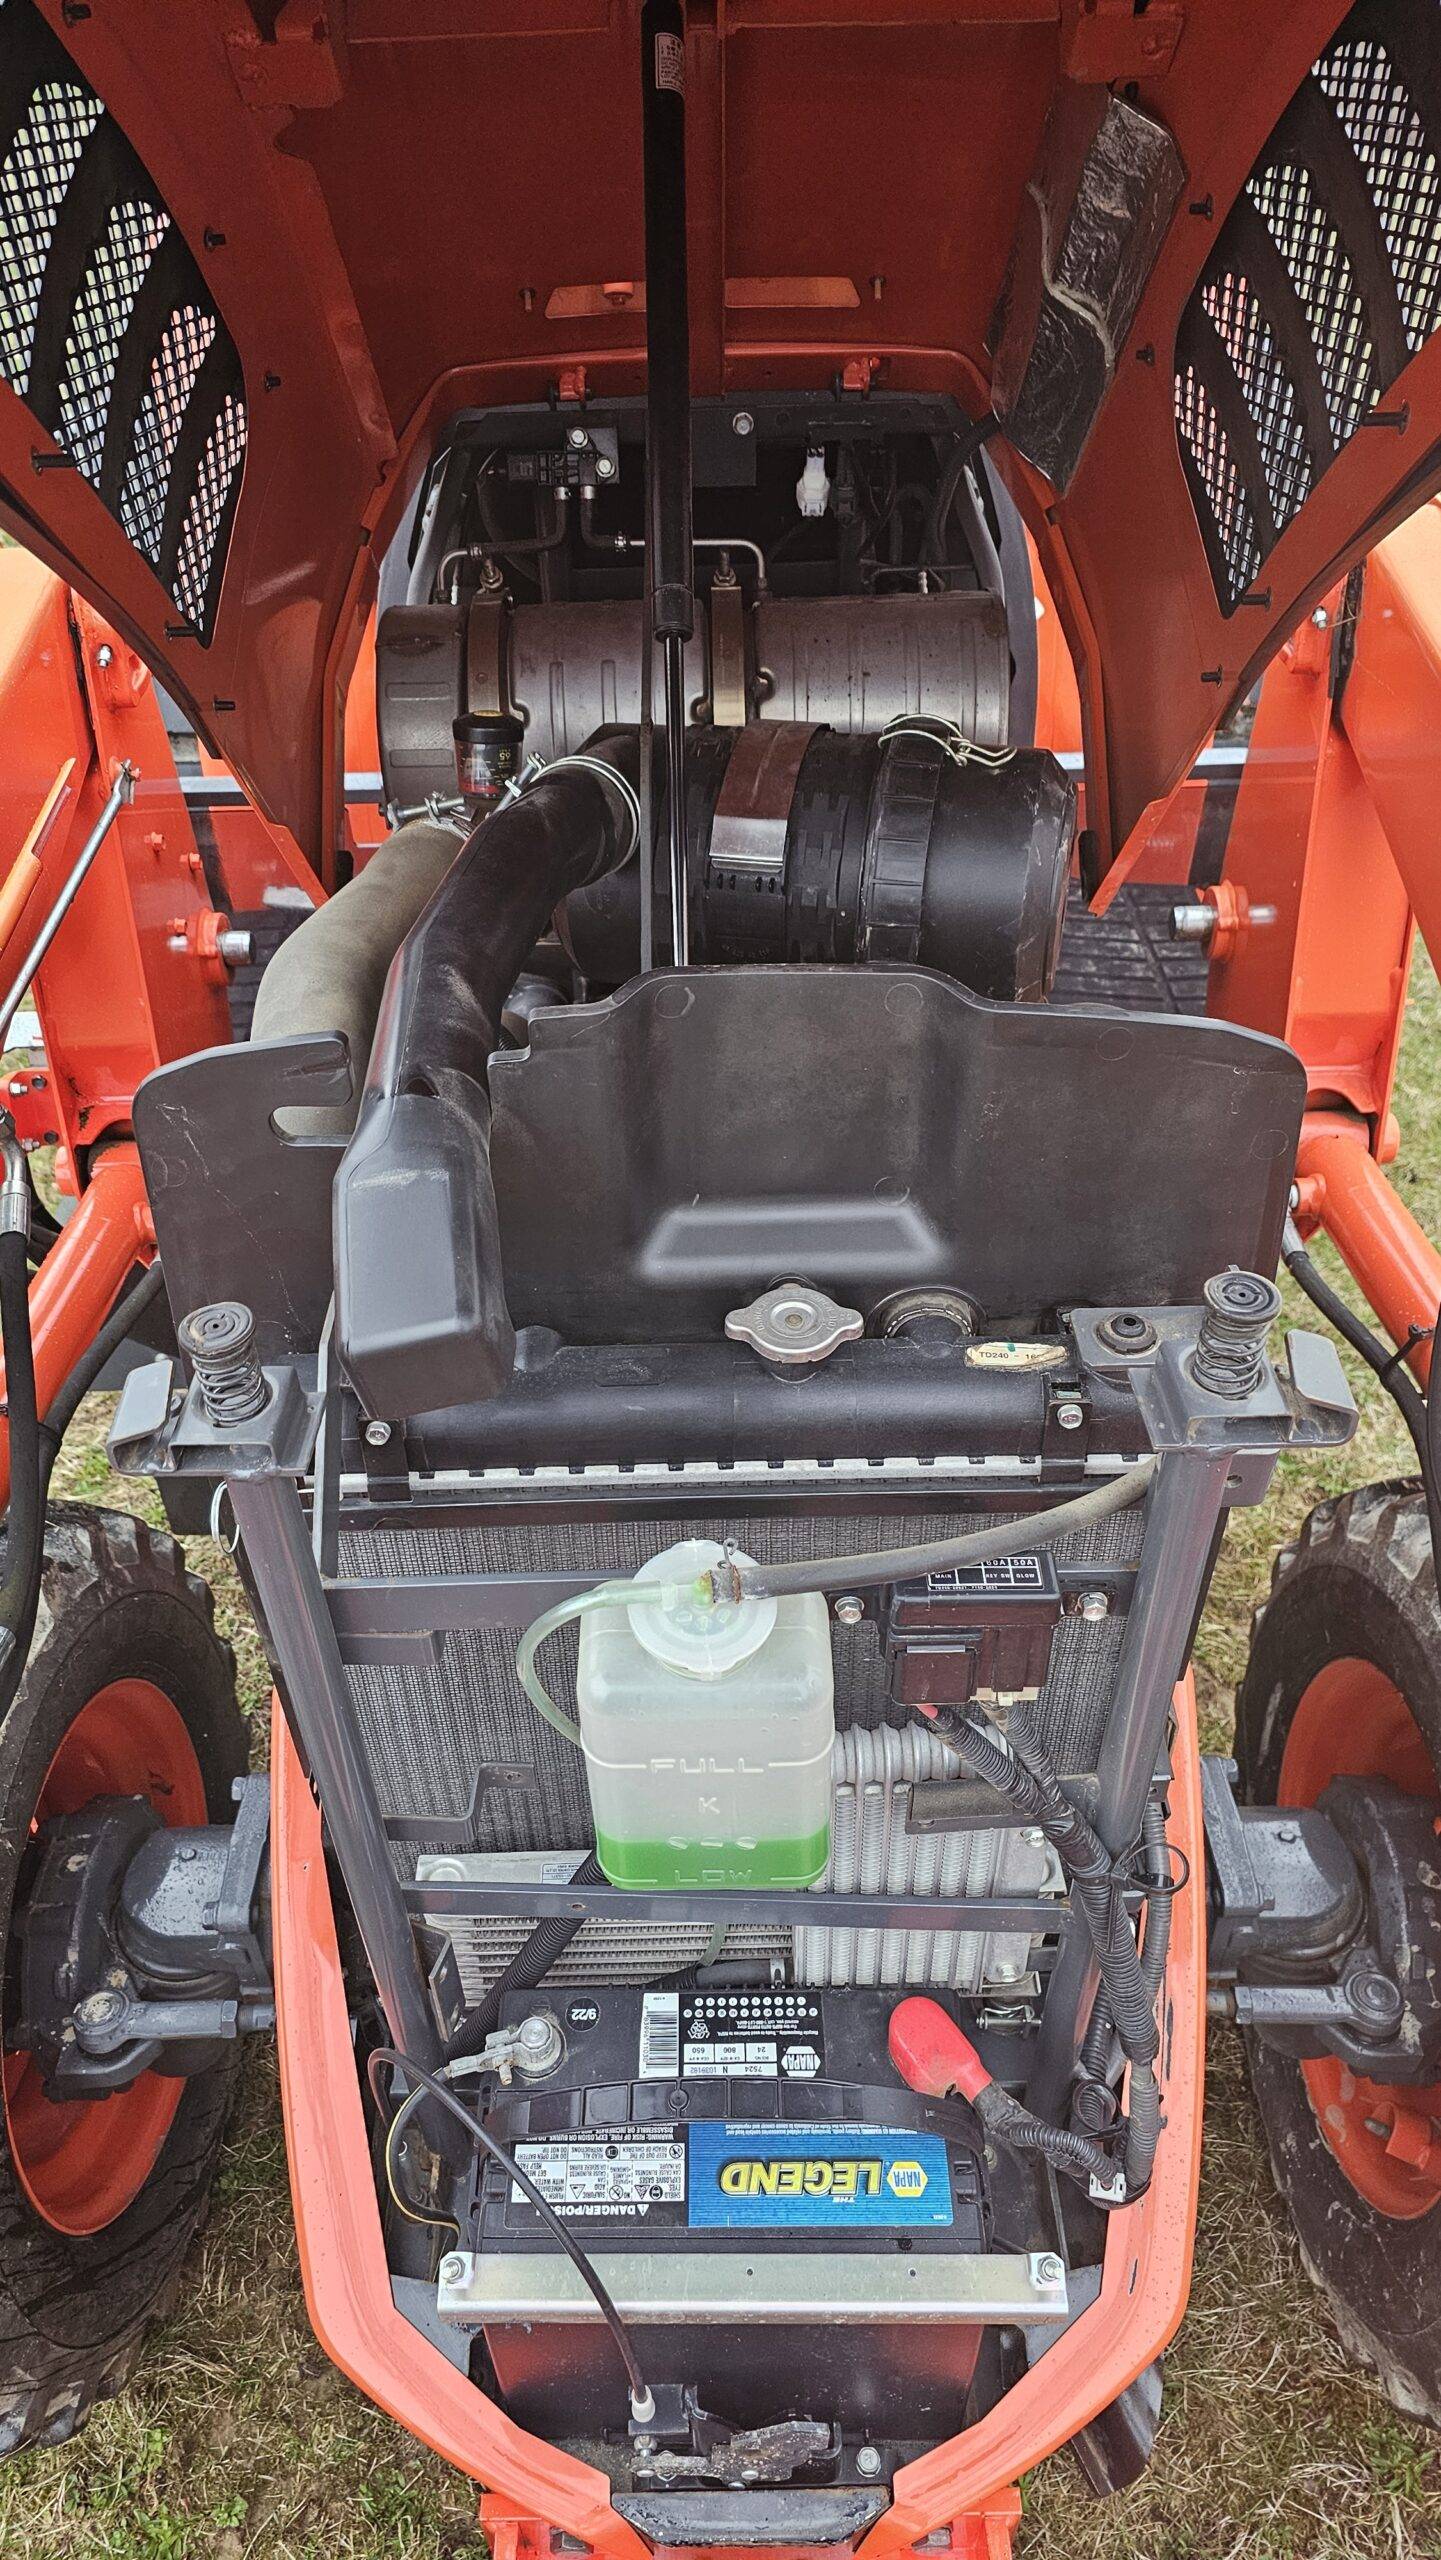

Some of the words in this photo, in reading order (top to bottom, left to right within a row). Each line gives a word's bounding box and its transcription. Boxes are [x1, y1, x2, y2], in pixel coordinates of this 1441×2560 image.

[979, 1351, 1009, 1359] TD240
[651, 1758, 764, 1776] FULL
[698, 1797, 720, 1814] K
[675, 1869, 752, 1883] LOW
[571, 2008, 597, 2021] 9/22
[787, 2054, 814, 2070] NAPA
[722, 2066, 728, 2074] N
[719, 2159, 883, 2196] LEGEND
[893, 2171, 921, 2187] NAPA
[536, 2204, 637, 2216] DANGER/POIS
